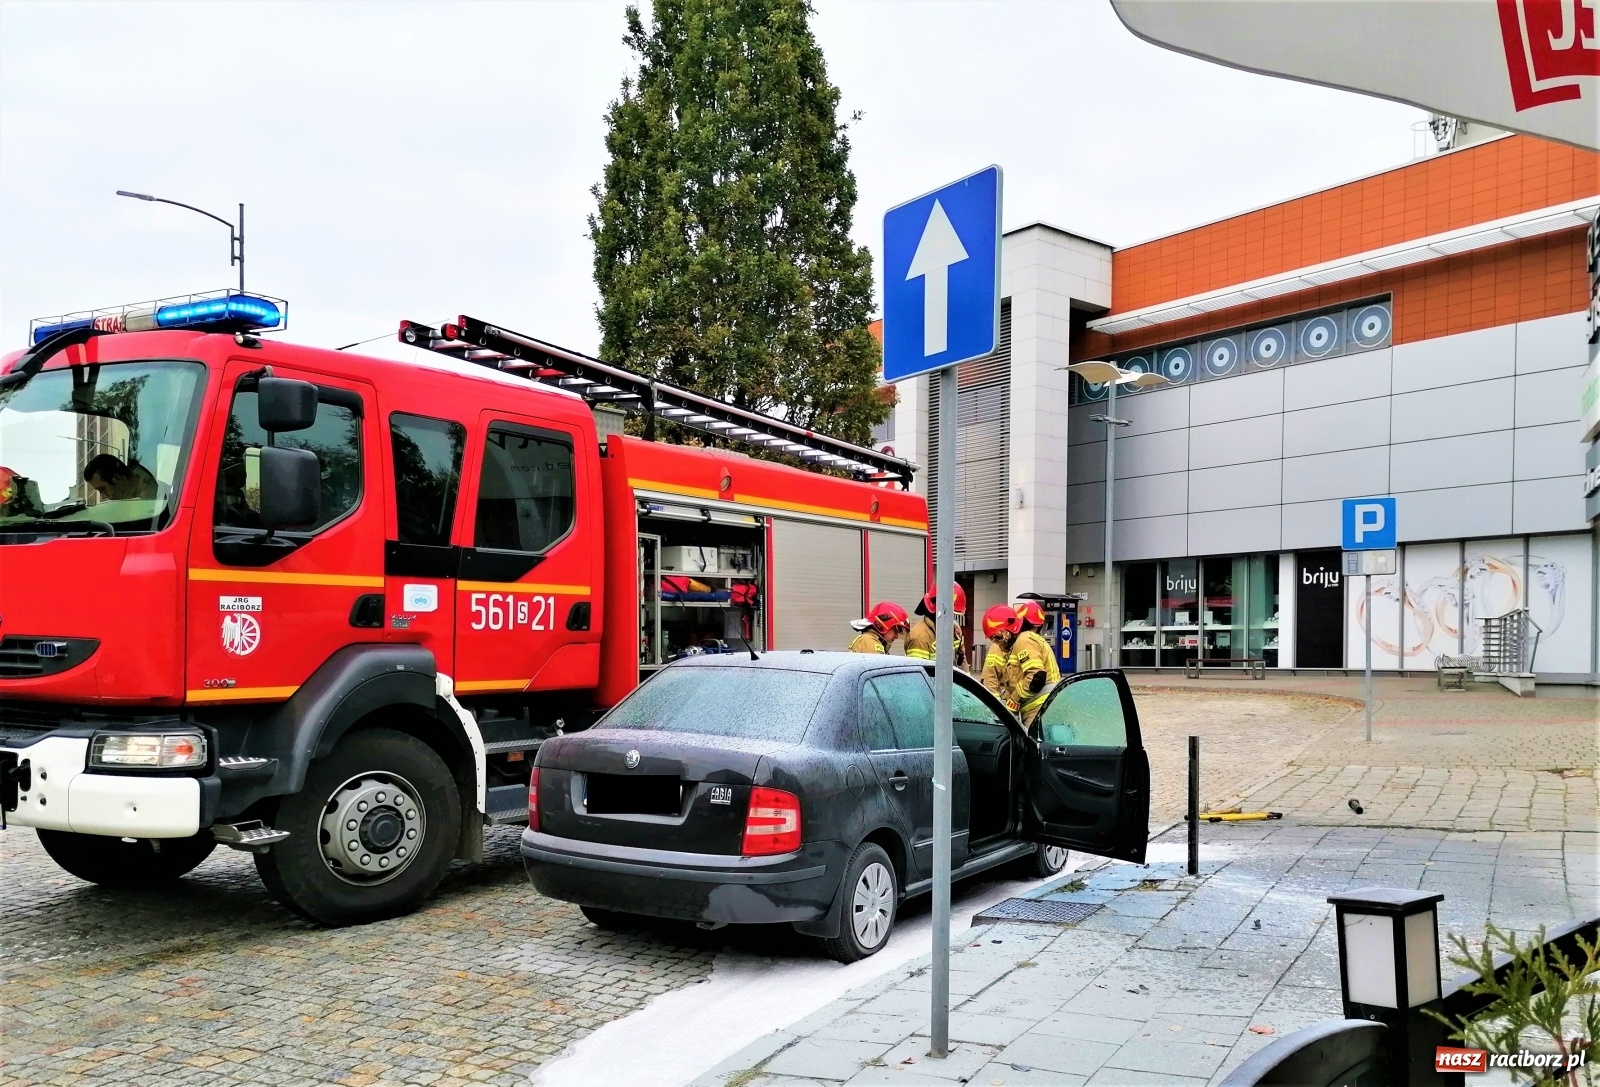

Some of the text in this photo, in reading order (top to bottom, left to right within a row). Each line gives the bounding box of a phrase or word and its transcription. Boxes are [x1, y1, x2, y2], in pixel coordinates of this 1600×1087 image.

[1354, 503, 1385, 543] P
[1166, 574, 1197, 594] briju
[1303, 566, 1339, 588] briju
[471, 593, 555, 631] 561 S 21
[711, 787, 732, 801] FABIA
